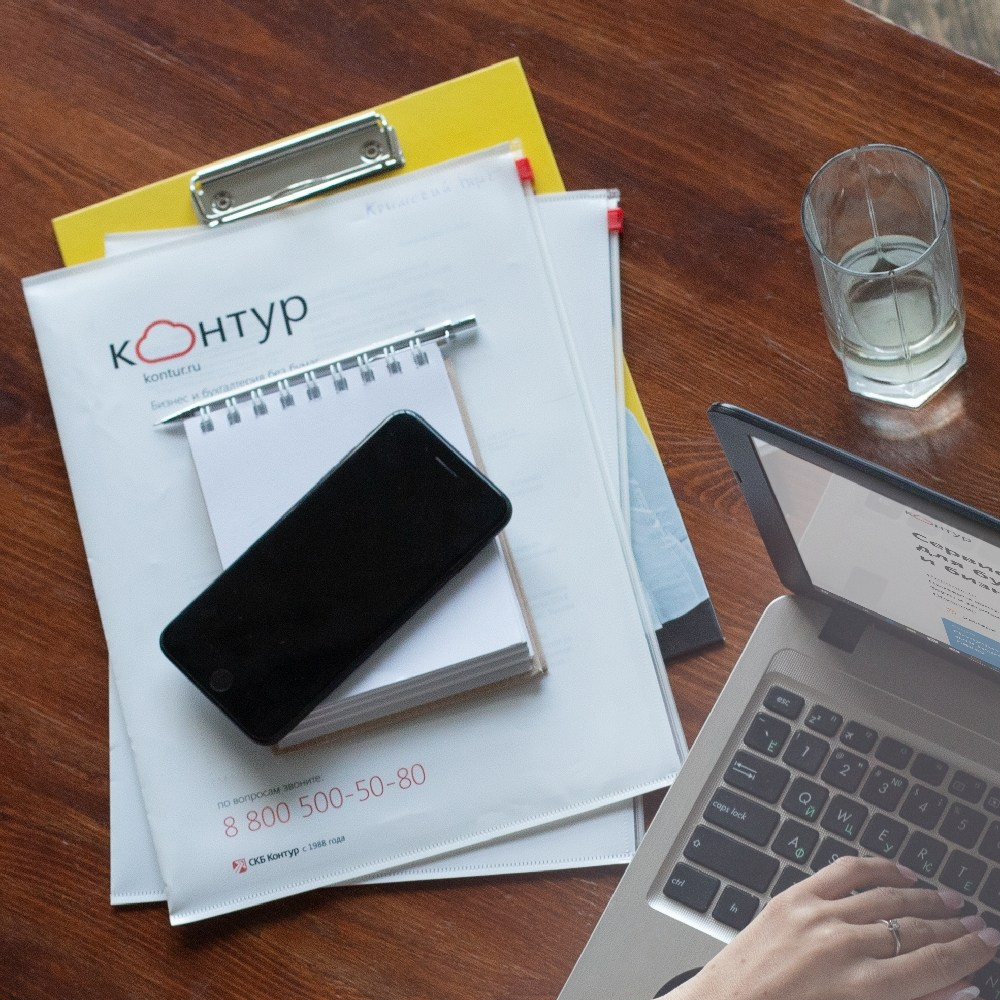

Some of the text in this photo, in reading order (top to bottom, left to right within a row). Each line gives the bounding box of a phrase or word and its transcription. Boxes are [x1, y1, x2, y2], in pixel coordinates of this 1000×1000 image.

[143, 363, 202, 384] kontur.ru
[150, 396, 188, 411] Бизнес
[776, 695, 791, 707] esc
[217, 800, 231, 810] по
[233, 787, 281, 806] вопросам
[223, 763, 426, 837] 8 800 500-50-80
[712, 800, 747, 821] caps lock
[248, 854, 266, 867] СКБ
[267, 846, 300, 863] Контур
[308, 840, 327, 851] 1988
[328, 834, 346, 848] года
[671, 877, 685, 888] ctrl
[729, 902, 738, 913] fn
